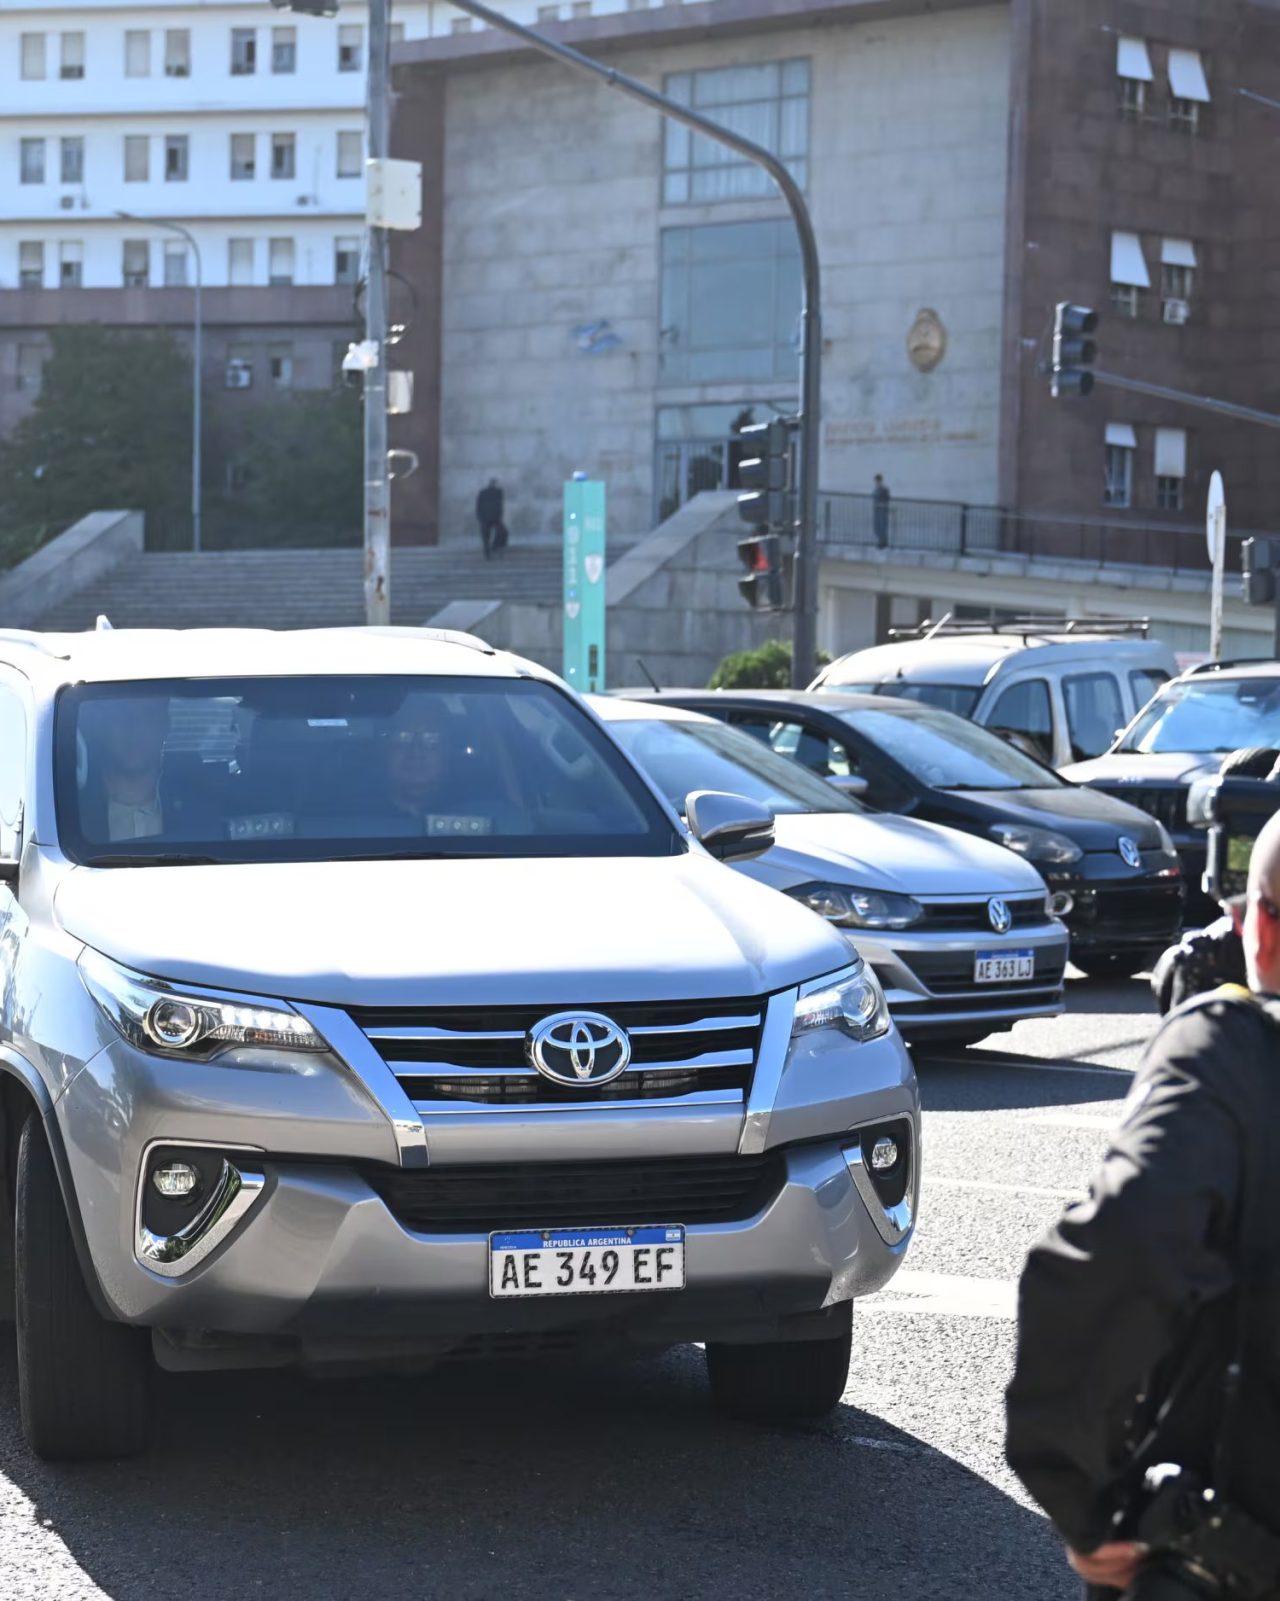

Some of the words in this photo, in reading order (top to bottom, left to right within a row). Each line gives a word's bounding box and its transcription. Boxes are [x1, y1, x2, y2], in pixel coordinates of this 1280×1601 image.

[978, 961, 992, 979] AE
[995, 960, 1015, 978] 363
[1018, 959, 1032, 977] LJ
[542, 1239, 586, 1249] REPUBLICA
[587, 1236, 632, 1247] ARGENTINA
[501, 1253, 542, 1289] AE
[556, 1250, 620, 1287] 349
[633, 1247, 675, 1283] EF
